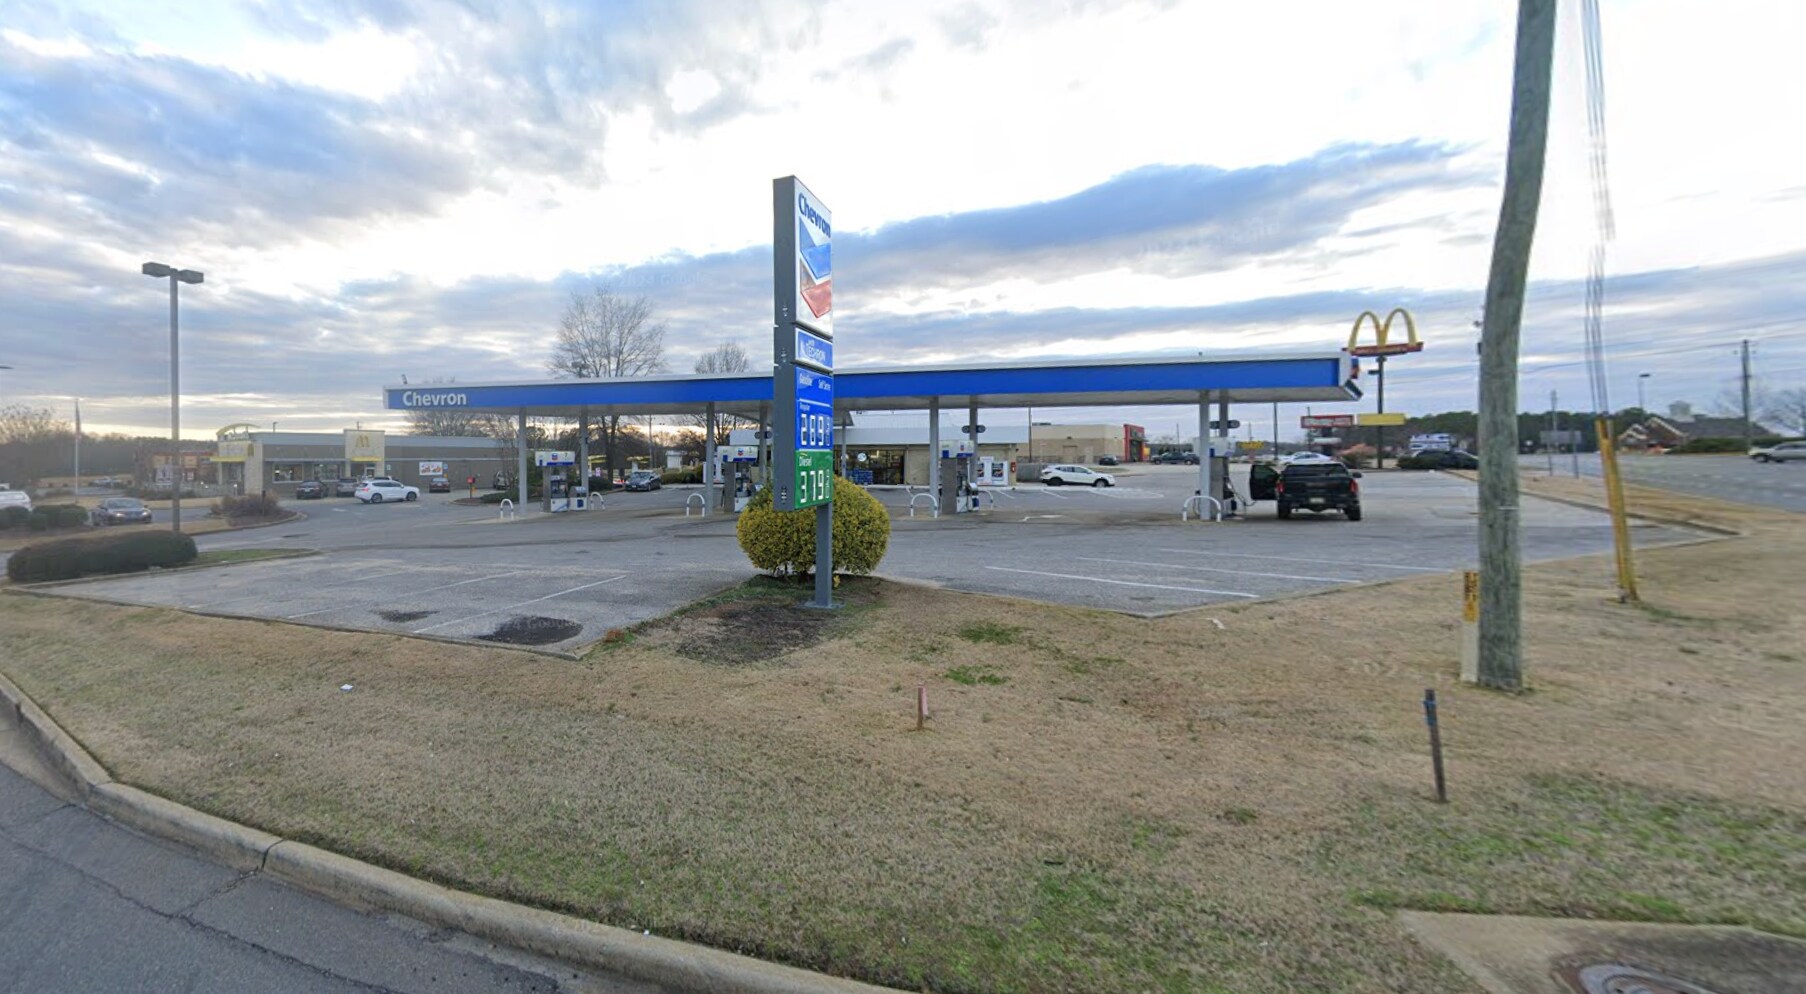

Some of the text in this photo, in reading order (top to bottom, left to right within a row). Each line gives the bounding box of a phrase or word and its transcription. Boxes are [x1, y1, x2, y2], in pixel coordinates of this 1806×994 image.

[798, 192, 831, 239] Chevron
[402, 391, 467, 406] Chevron
[799, 455, 812, 467] Diesel
